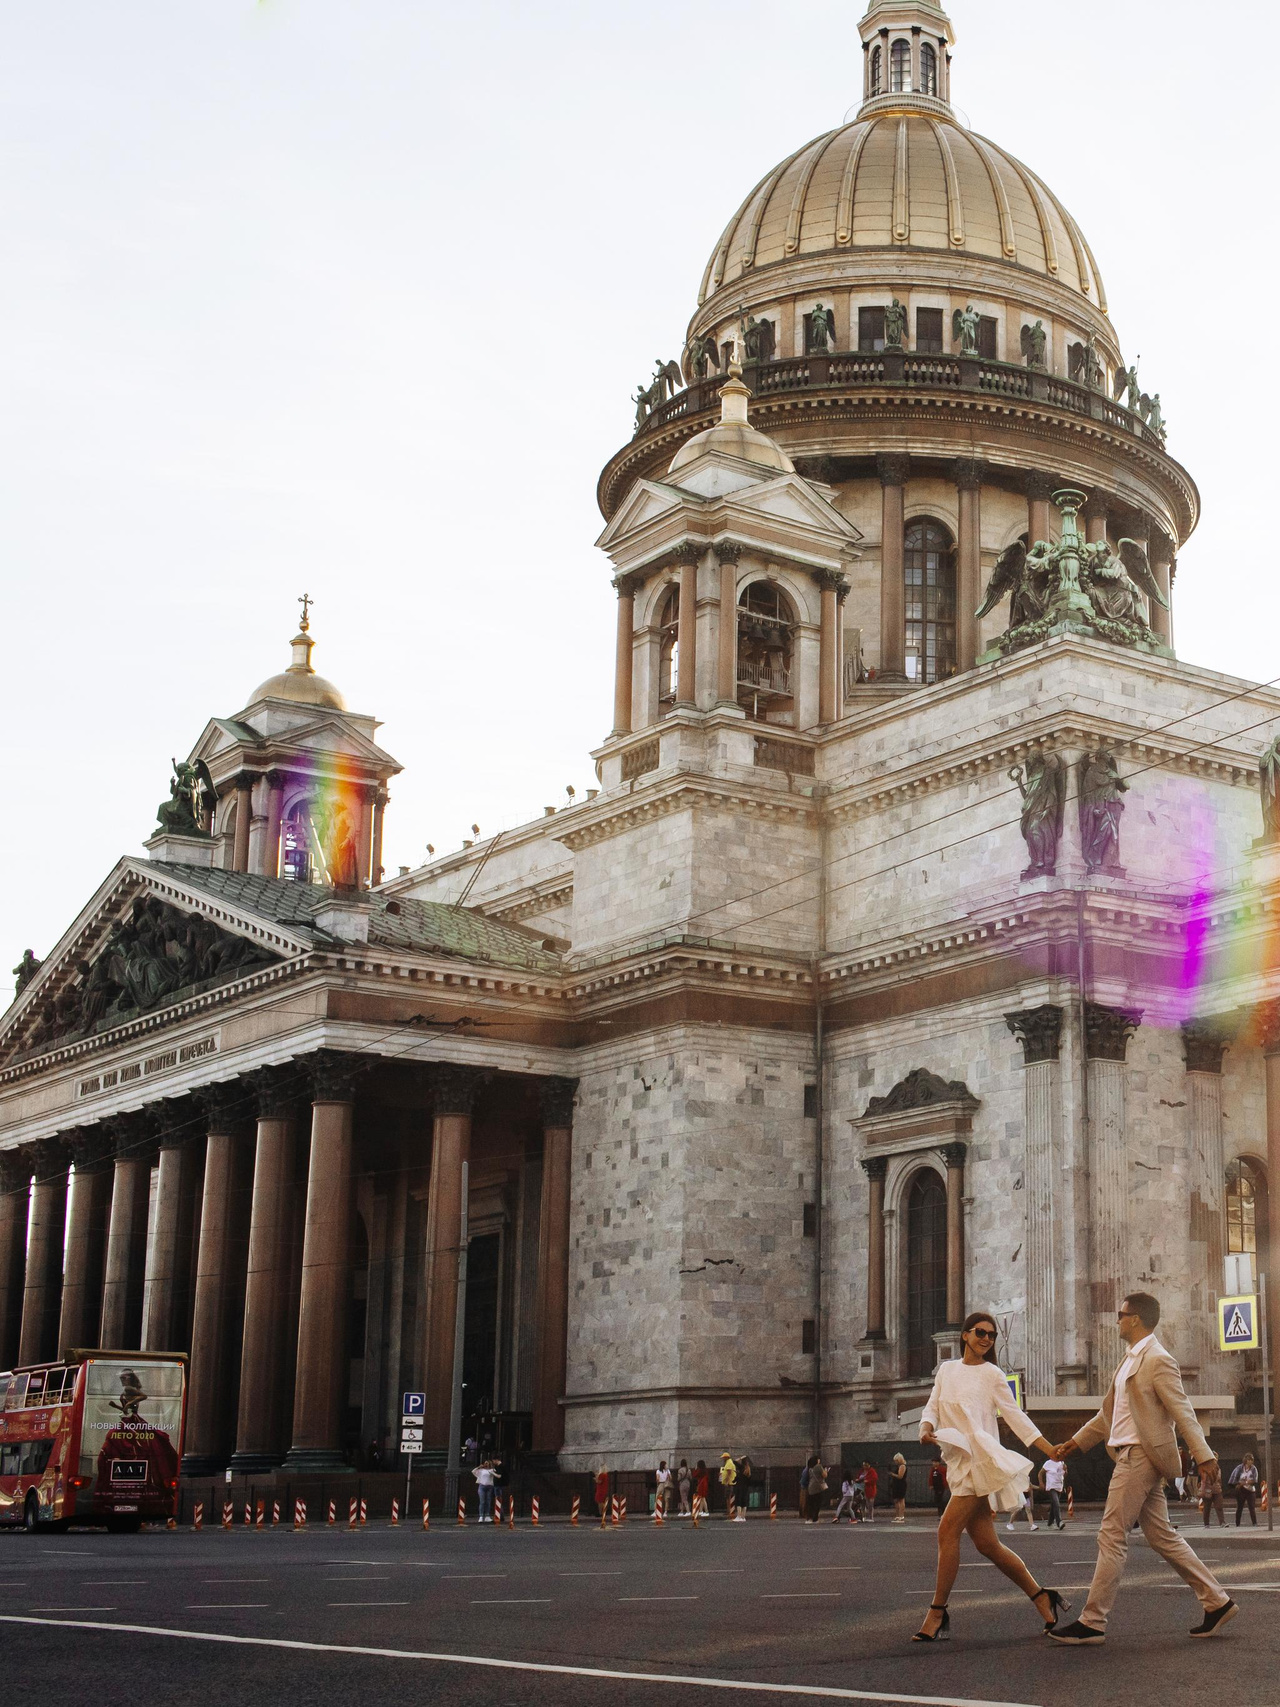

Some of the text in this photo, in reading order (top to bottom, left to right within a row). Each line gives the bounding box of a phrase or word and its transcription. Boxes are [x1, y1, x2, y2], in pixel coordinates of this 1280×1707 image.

[409, 1395, 421, 1413] P
[90, 1422, 175, 1431] НОВЫЕ КОЛЛЕКЦИИ
[135, 1432, 155, 1440] 2020
